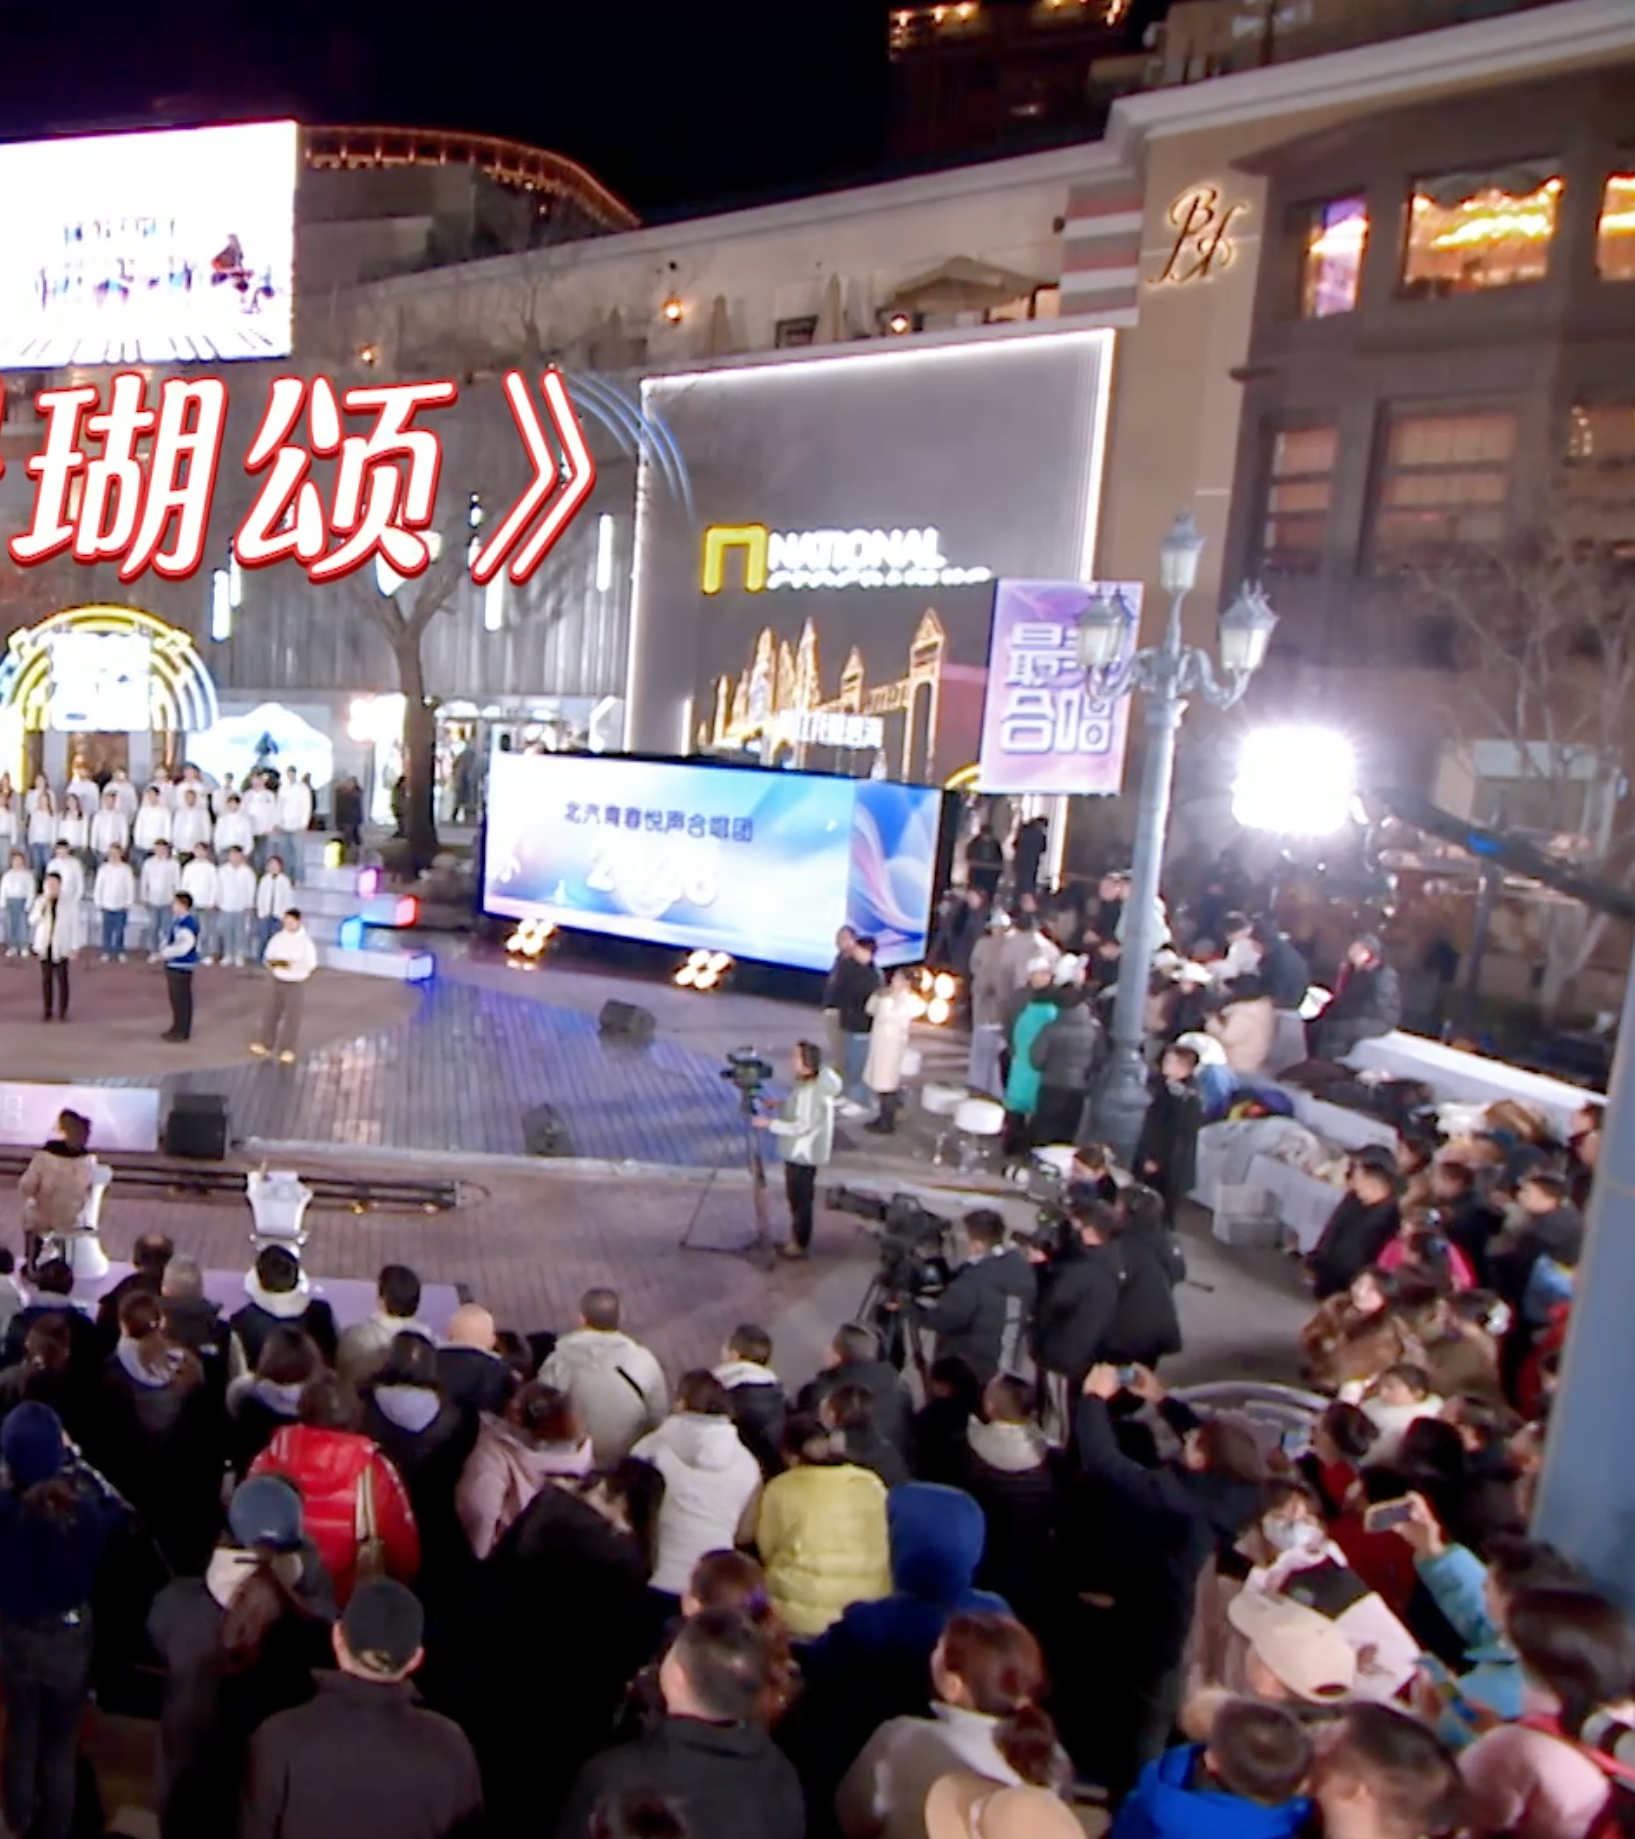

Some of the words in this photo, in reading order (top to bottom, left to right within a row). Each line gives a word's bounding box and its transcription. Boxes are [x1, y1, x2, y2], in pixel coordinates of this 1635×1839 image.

[766, 526, 948, 571] NATIONAL
[1006, 622, 1114, 688] 最
[564, 801, 754, 842] 北汽青春悦声合唱团
